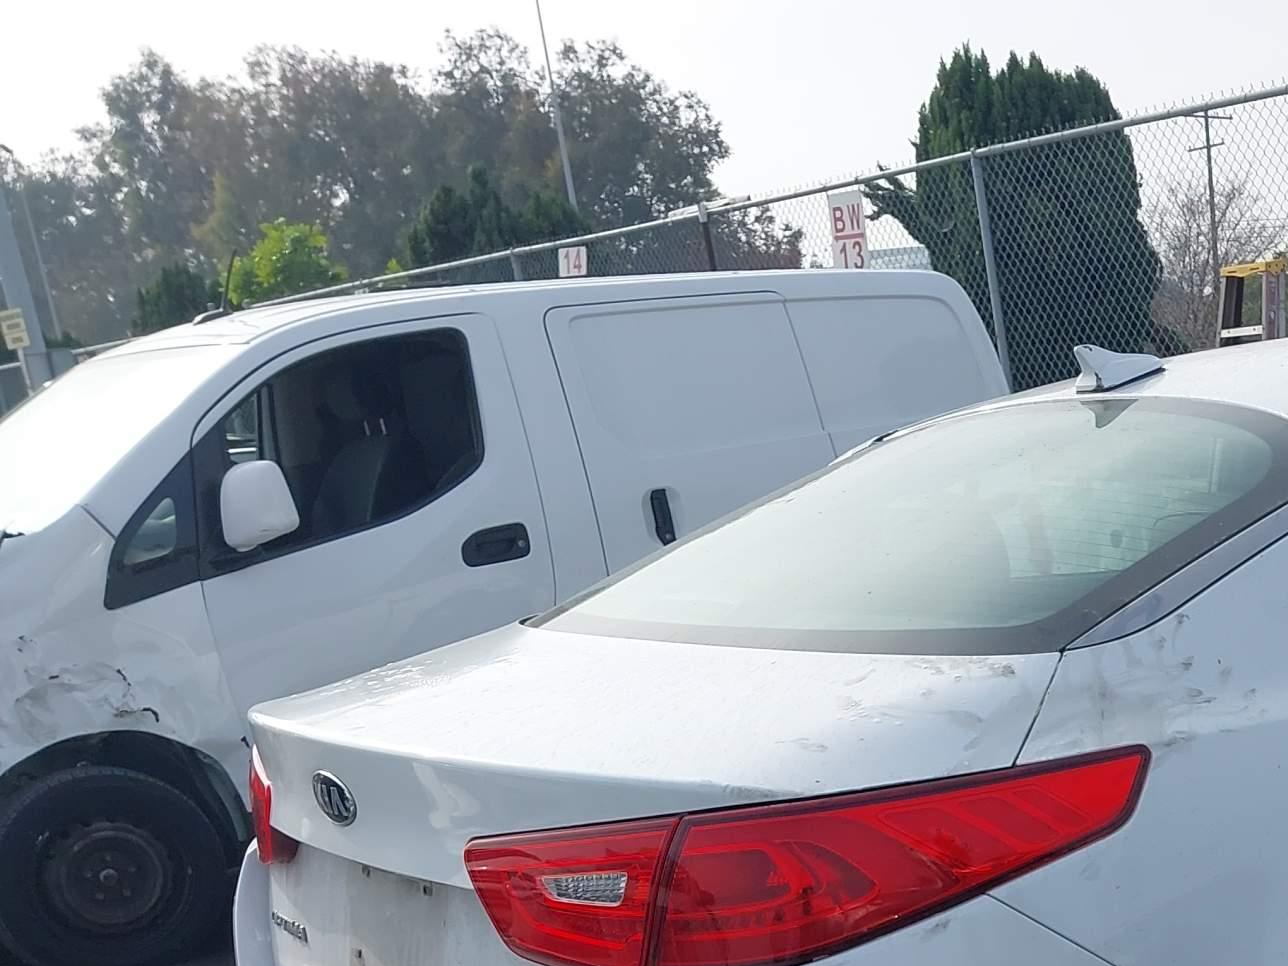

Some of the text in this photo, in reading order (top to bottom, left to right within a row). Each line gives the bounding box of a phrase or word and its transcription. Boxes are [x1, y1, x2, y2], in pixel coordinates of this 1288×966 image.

[832, 203, 861, 233] BW
[563, 247, 583, 274] 14
[840, 241, 864, 269] 13
